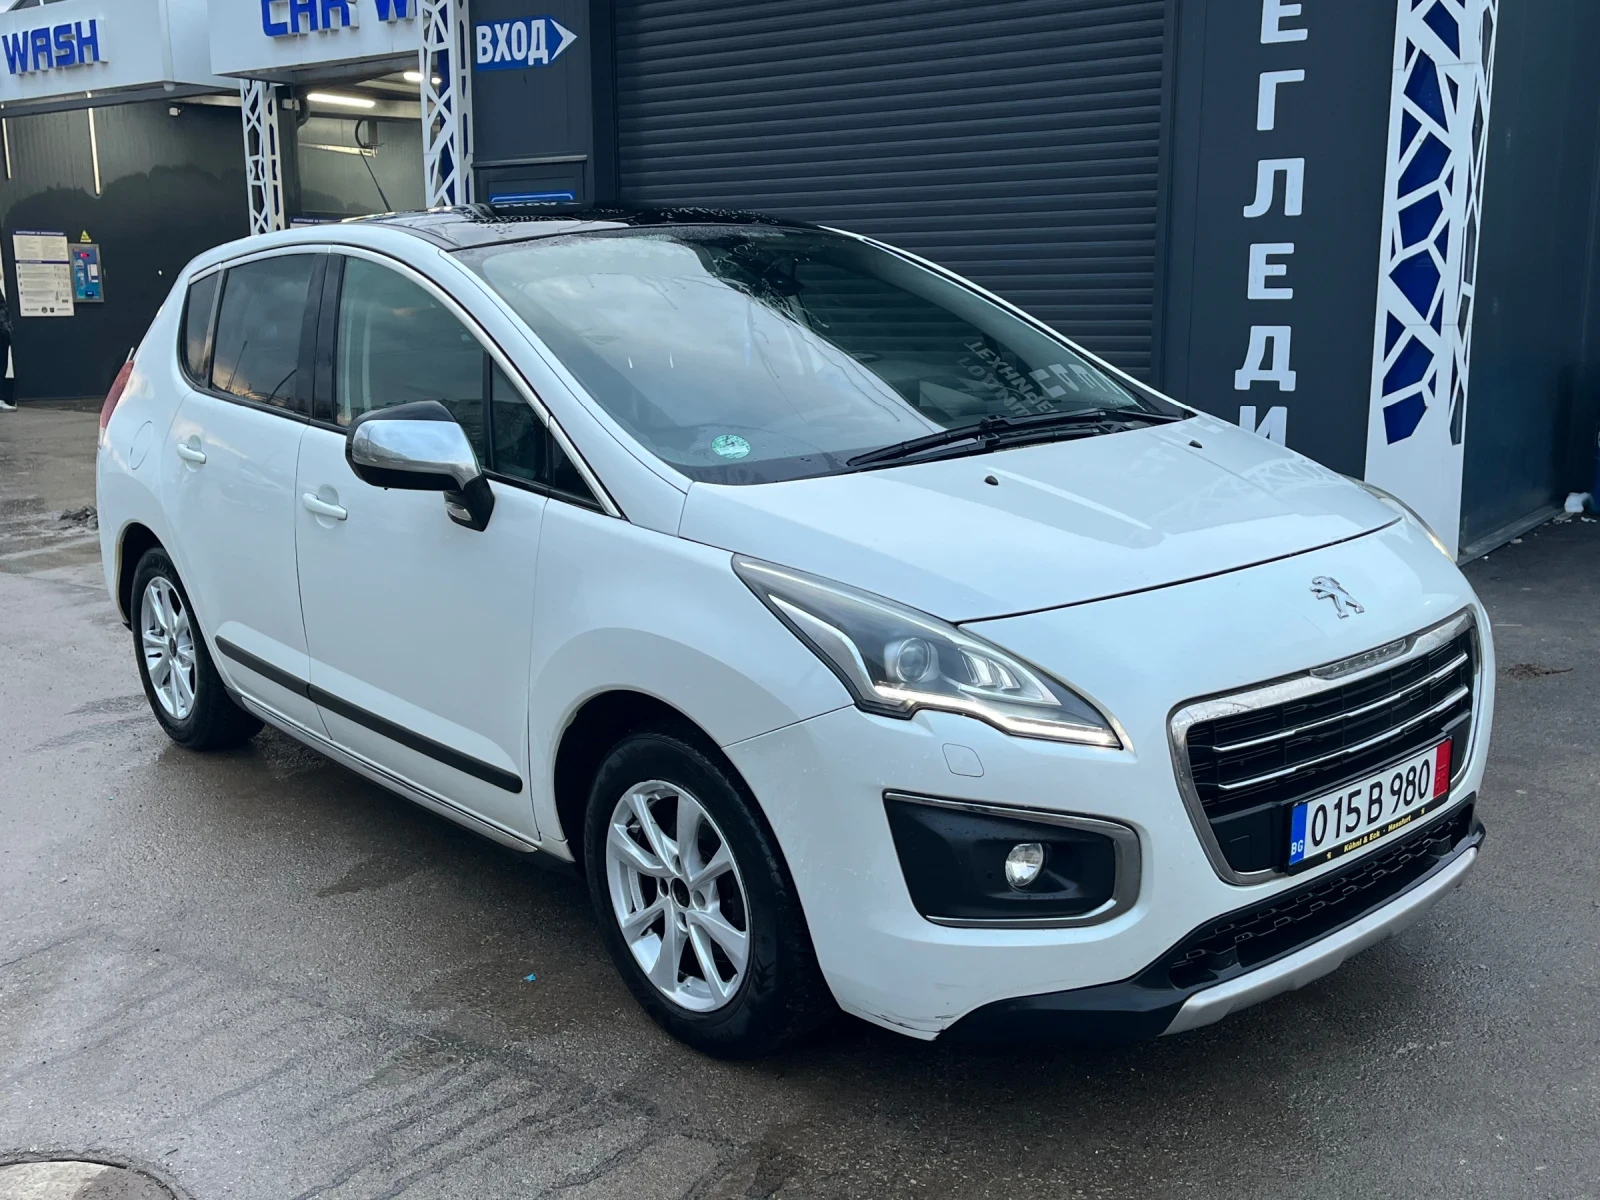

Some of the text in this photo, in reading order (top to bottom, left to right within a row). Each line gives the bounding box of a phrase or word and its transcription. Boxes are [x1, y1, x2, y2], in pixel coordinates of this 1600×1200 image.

[1, 19, 100, 75] WASH
[475, 19, 549, 65] ВХОД
[1291, 839, 1304, 856] BG
